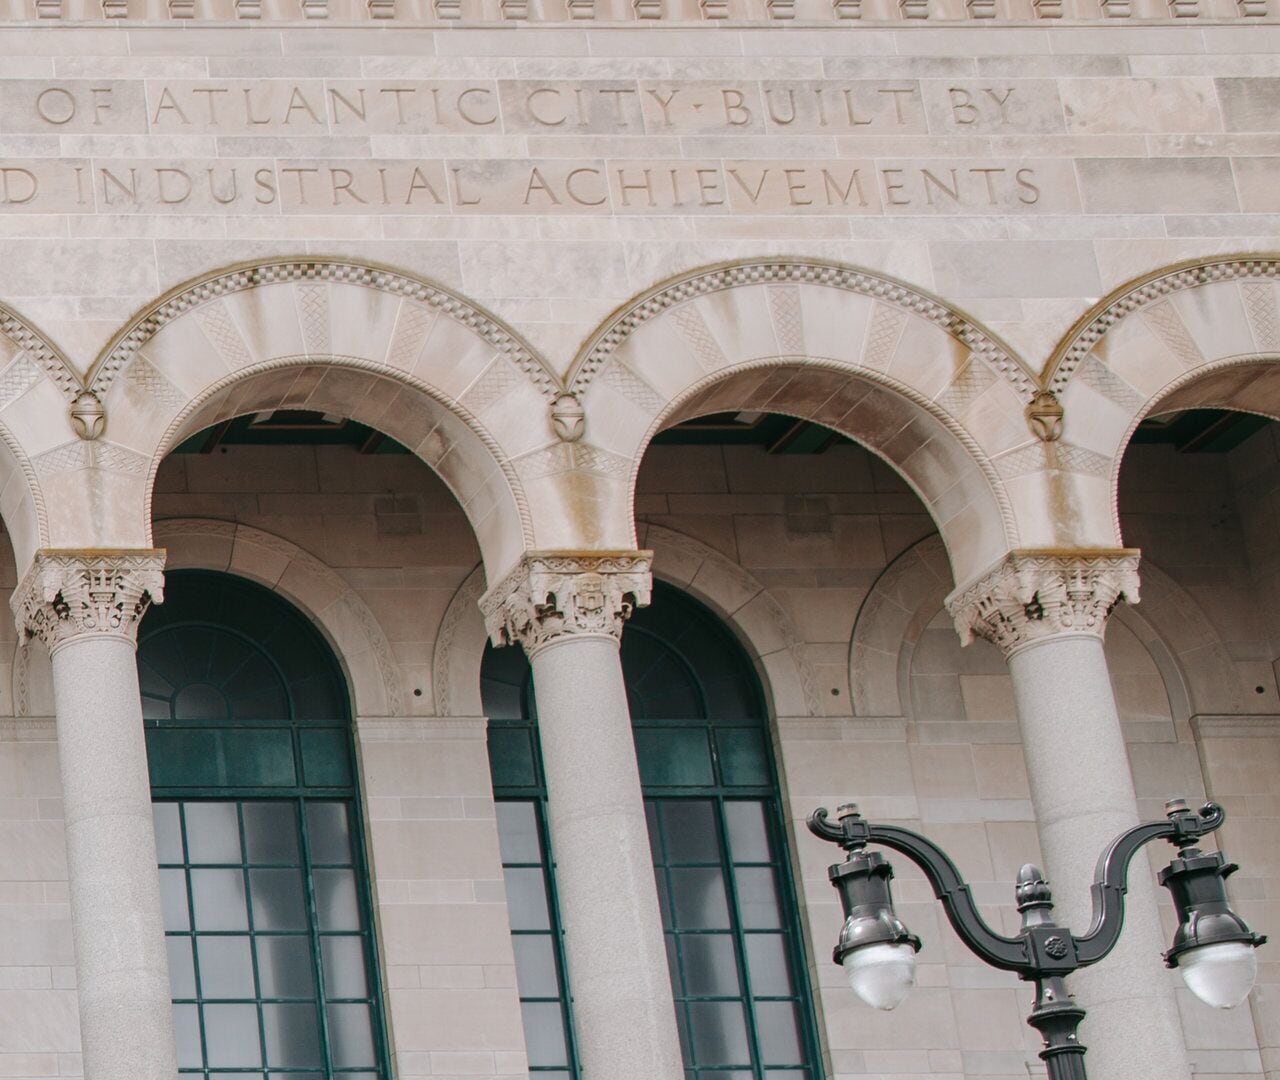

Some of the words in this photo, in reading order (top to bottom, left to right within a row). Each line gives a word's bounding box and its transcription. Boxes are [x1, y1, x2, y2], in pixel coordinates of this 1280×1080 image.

[35, 86, 114, 126] OF
[151, 86, 500, 126] ATLANTIC
[525, 87, 685, 127] CITY
[721, 87, 915, 127] BUILT
[950, 86, 1016, 126] BY
[74, 166, 482, 206] INDUSTRIAL
[523, 166, 1041, 207] ACHIEVEMENTS
